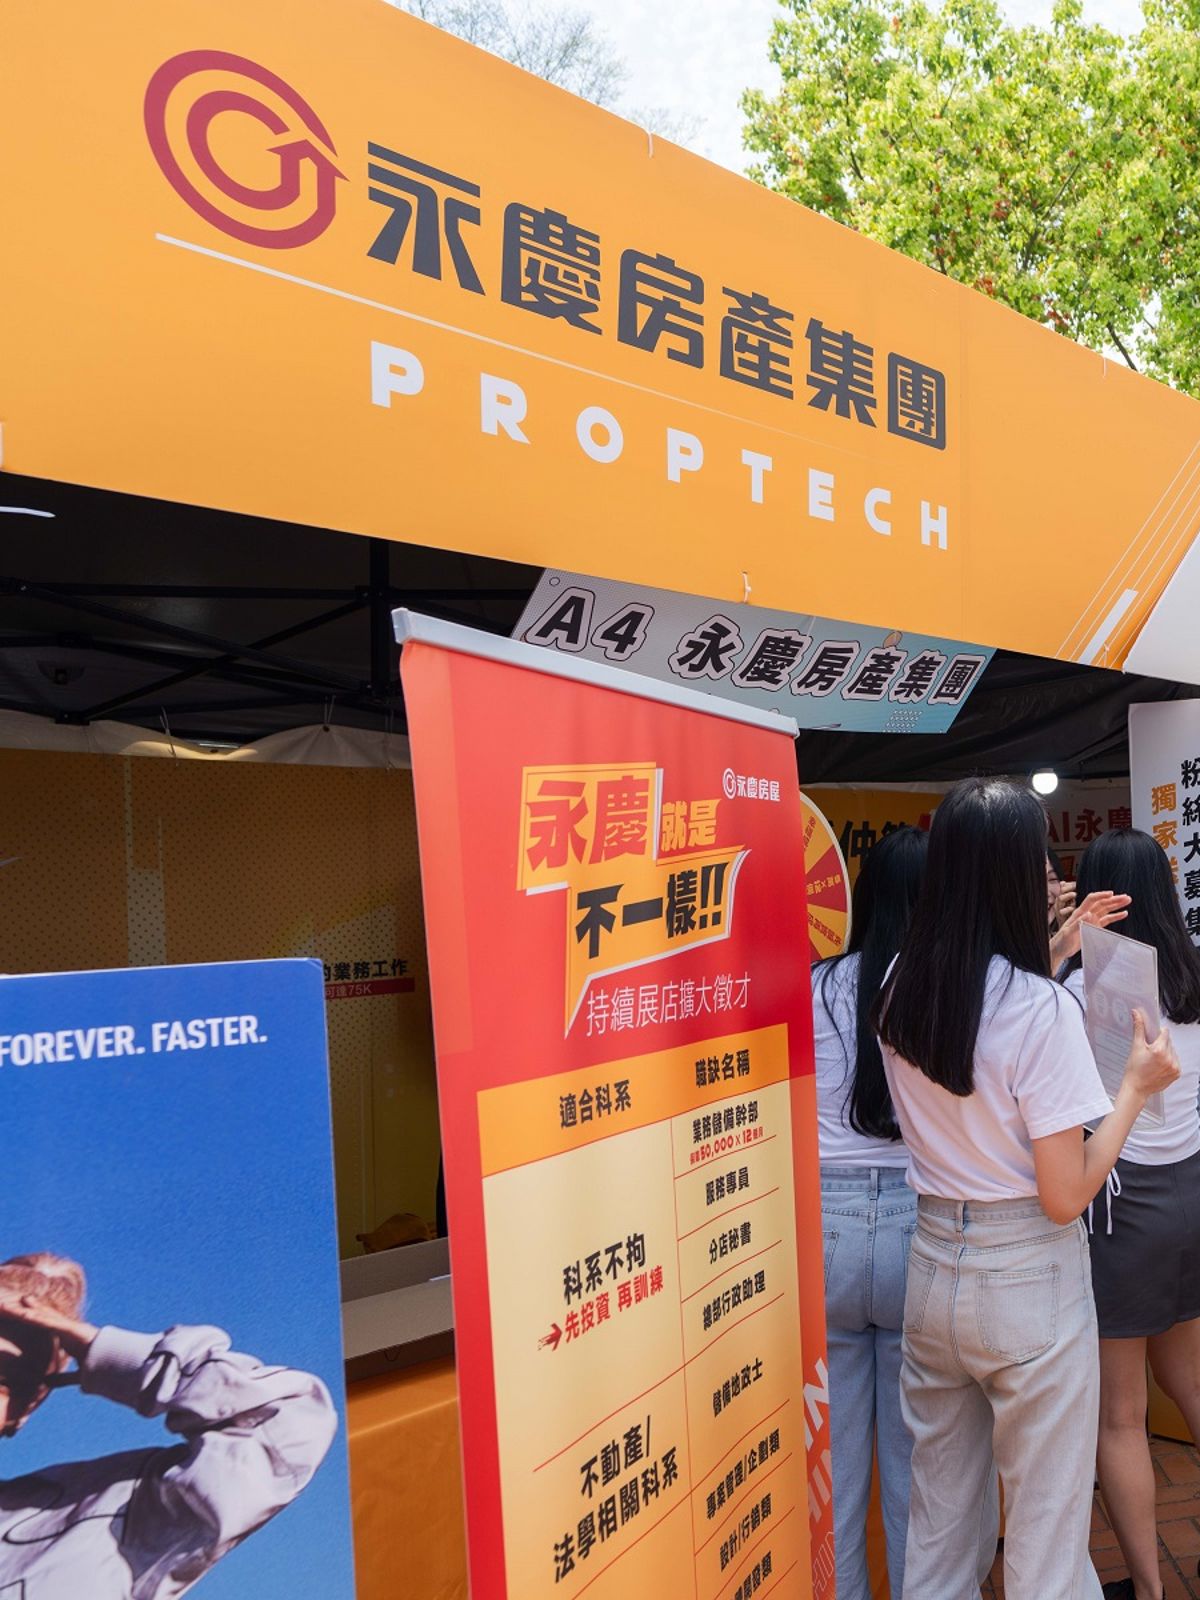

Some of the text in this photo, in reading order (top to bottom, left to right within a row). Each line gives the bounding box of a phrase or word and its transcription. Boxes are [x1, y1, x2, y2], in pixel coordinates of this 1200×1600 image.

[366, 140, 947, 451] 永慶房產集團
[370, 339, 949, 551] PROPTECH
[534, 593, 985, 704] A4 永慶房產集團
[526, 775, 653, 871] 永慶
[661, 799, 719, 851] 就是
[736, 775, 781, 802] 永慶房屋
[1151, 783, 1179, 905] 獨家
[575, 861, 730, 960] 不一樣!!
[586, 972, 752, 1038] 持續展店擴大徵才
[0, 1014, 268, 1068] FOREVER. FASTER.
[695, 1050, 751, 1088] 職缺名稱
[558, 1079, 632, 1128] 適合科系
[692, 1100, 759, 1144] 業務儲備幹部
[705, 1166, 750, 1207] 服務專員
[562, 1232, 646, 1305] 科系不拘
[708, 1222, 752, 1265] 分店秘書
[565, 1265, 664, 1344] 先投資 再訓練
[702, 1270, 767, 1332] 總部行政助理
[712, 1357, 764, 1418] 儲備地政士
[580, 1414, 653, 1500] 不動產/
[553, 1446, 680, 1584] 法學相關科系
